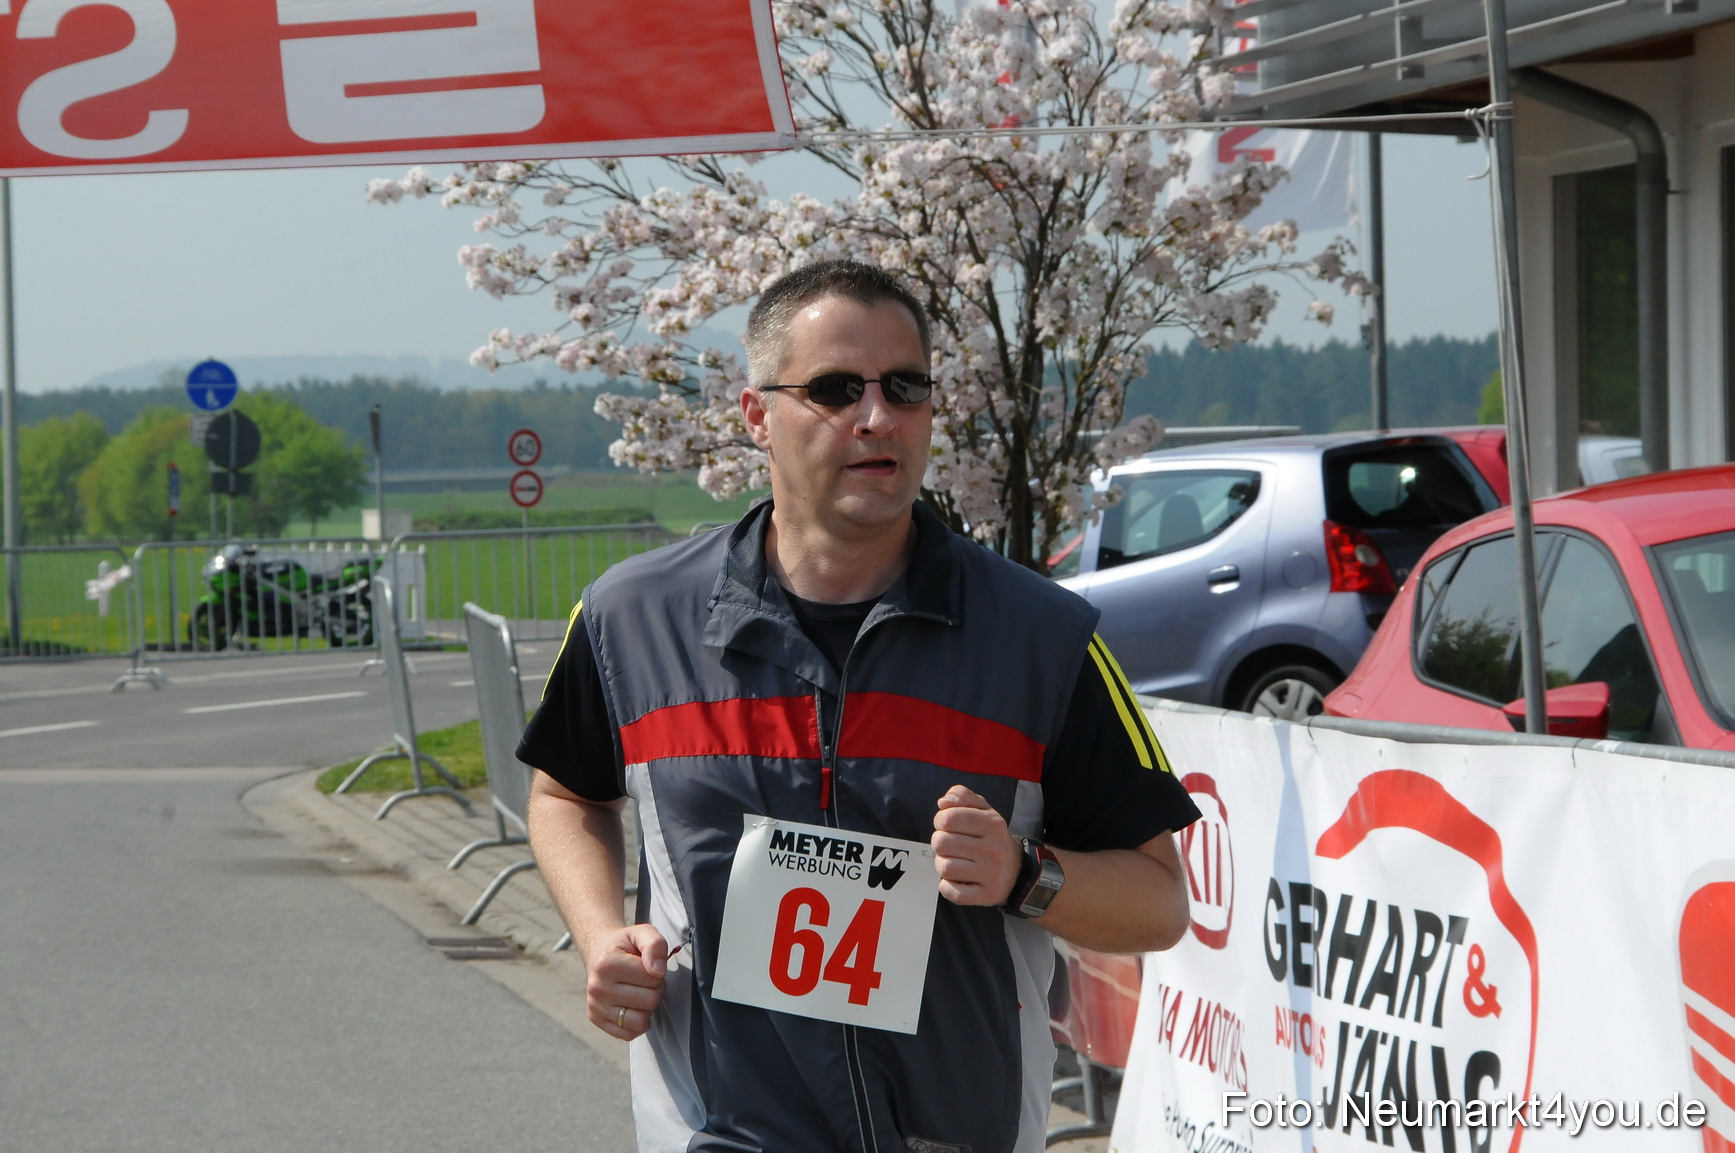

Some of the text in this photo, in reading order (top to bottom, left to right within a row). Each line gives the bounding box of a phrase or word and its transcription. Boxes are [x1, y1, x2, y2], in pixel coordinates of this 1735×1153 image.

[768, 851, 862, 881] WERBUNG
[769, 829, 864, 864] MEYER
[769, 886, 886, 1007] 64
[1264, 876, 1503, 1029] GERHART &
